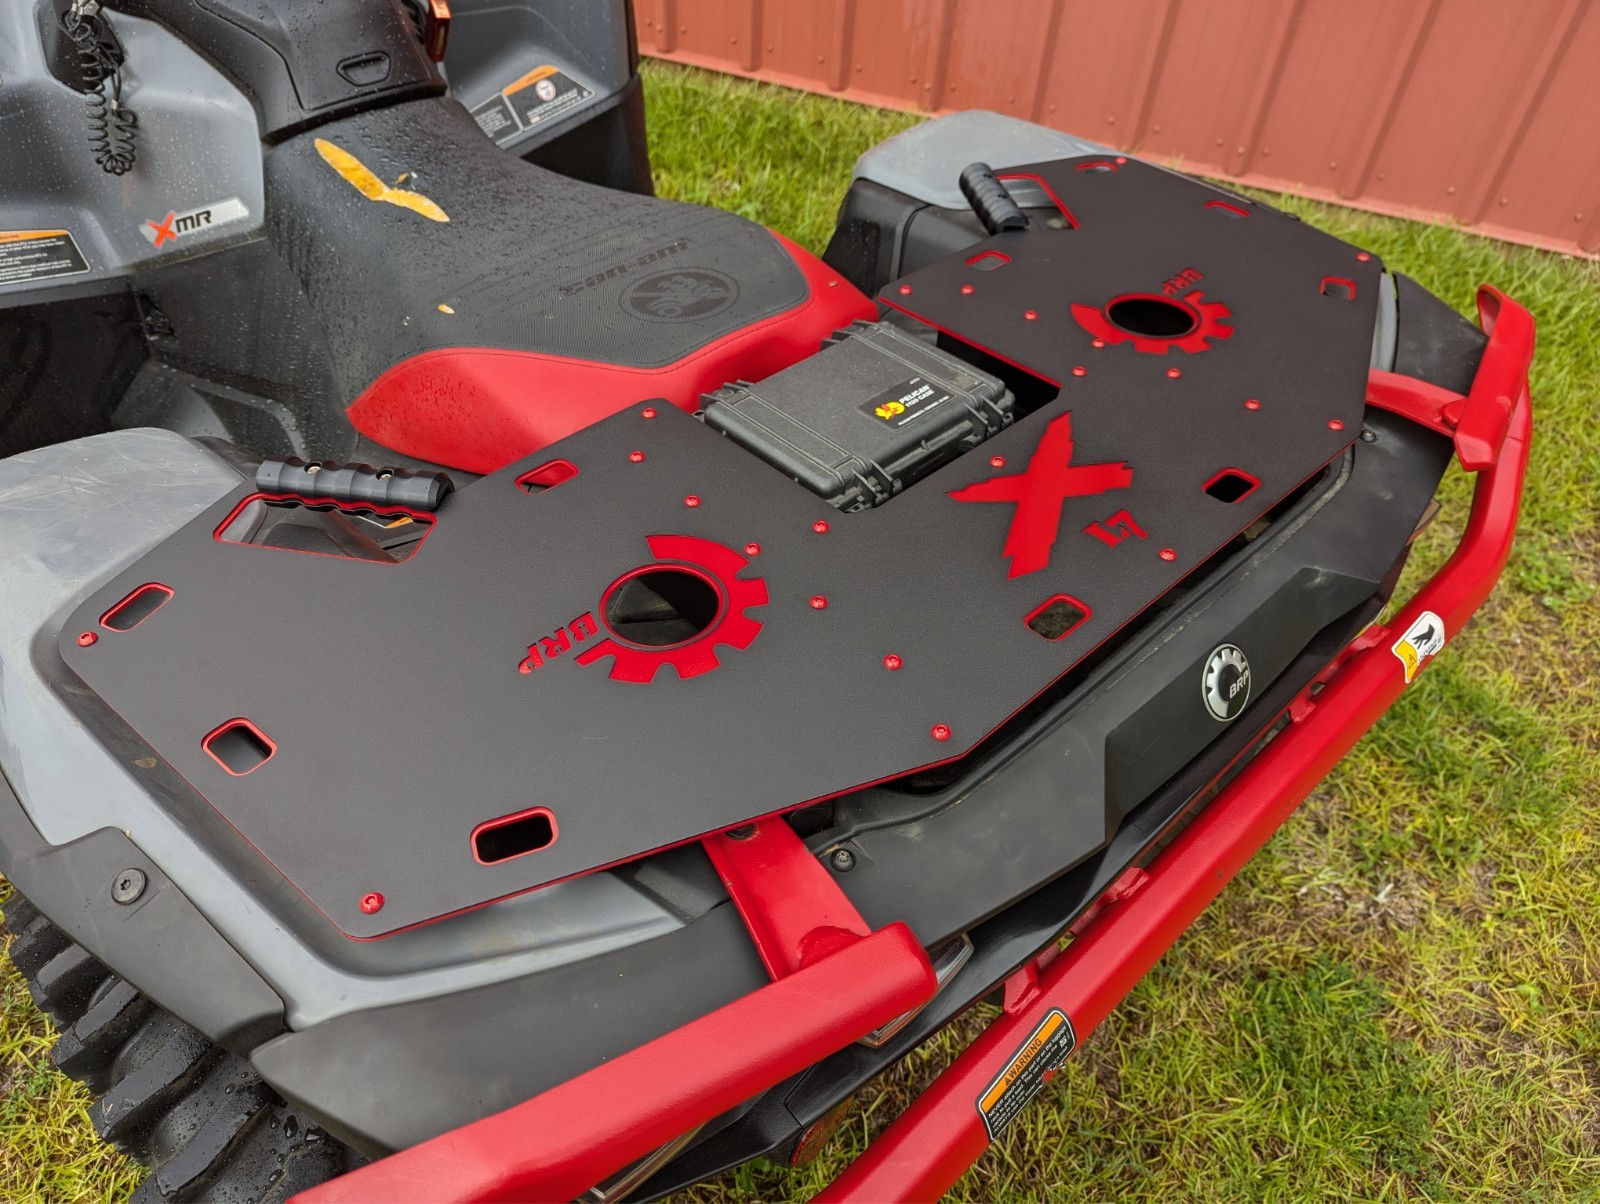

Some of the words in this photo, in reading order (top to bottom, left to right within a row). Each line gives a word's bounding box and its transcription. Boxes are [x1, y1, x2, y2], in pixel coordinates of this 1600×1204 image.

[899, 384, 930, 404] PELICAN
[518, 611, 599, 675] BRP
[1230, 670, 1249, 699] BRP
[1007, 1037, 1043, 1079] WARNING
[988, 1098, 1004, 1118] NEVER
[1020, 1070, 1029, 1080] this
[1028, 1060, 1037, 1073] part
[1023, 1073, 1033, 1084] This
